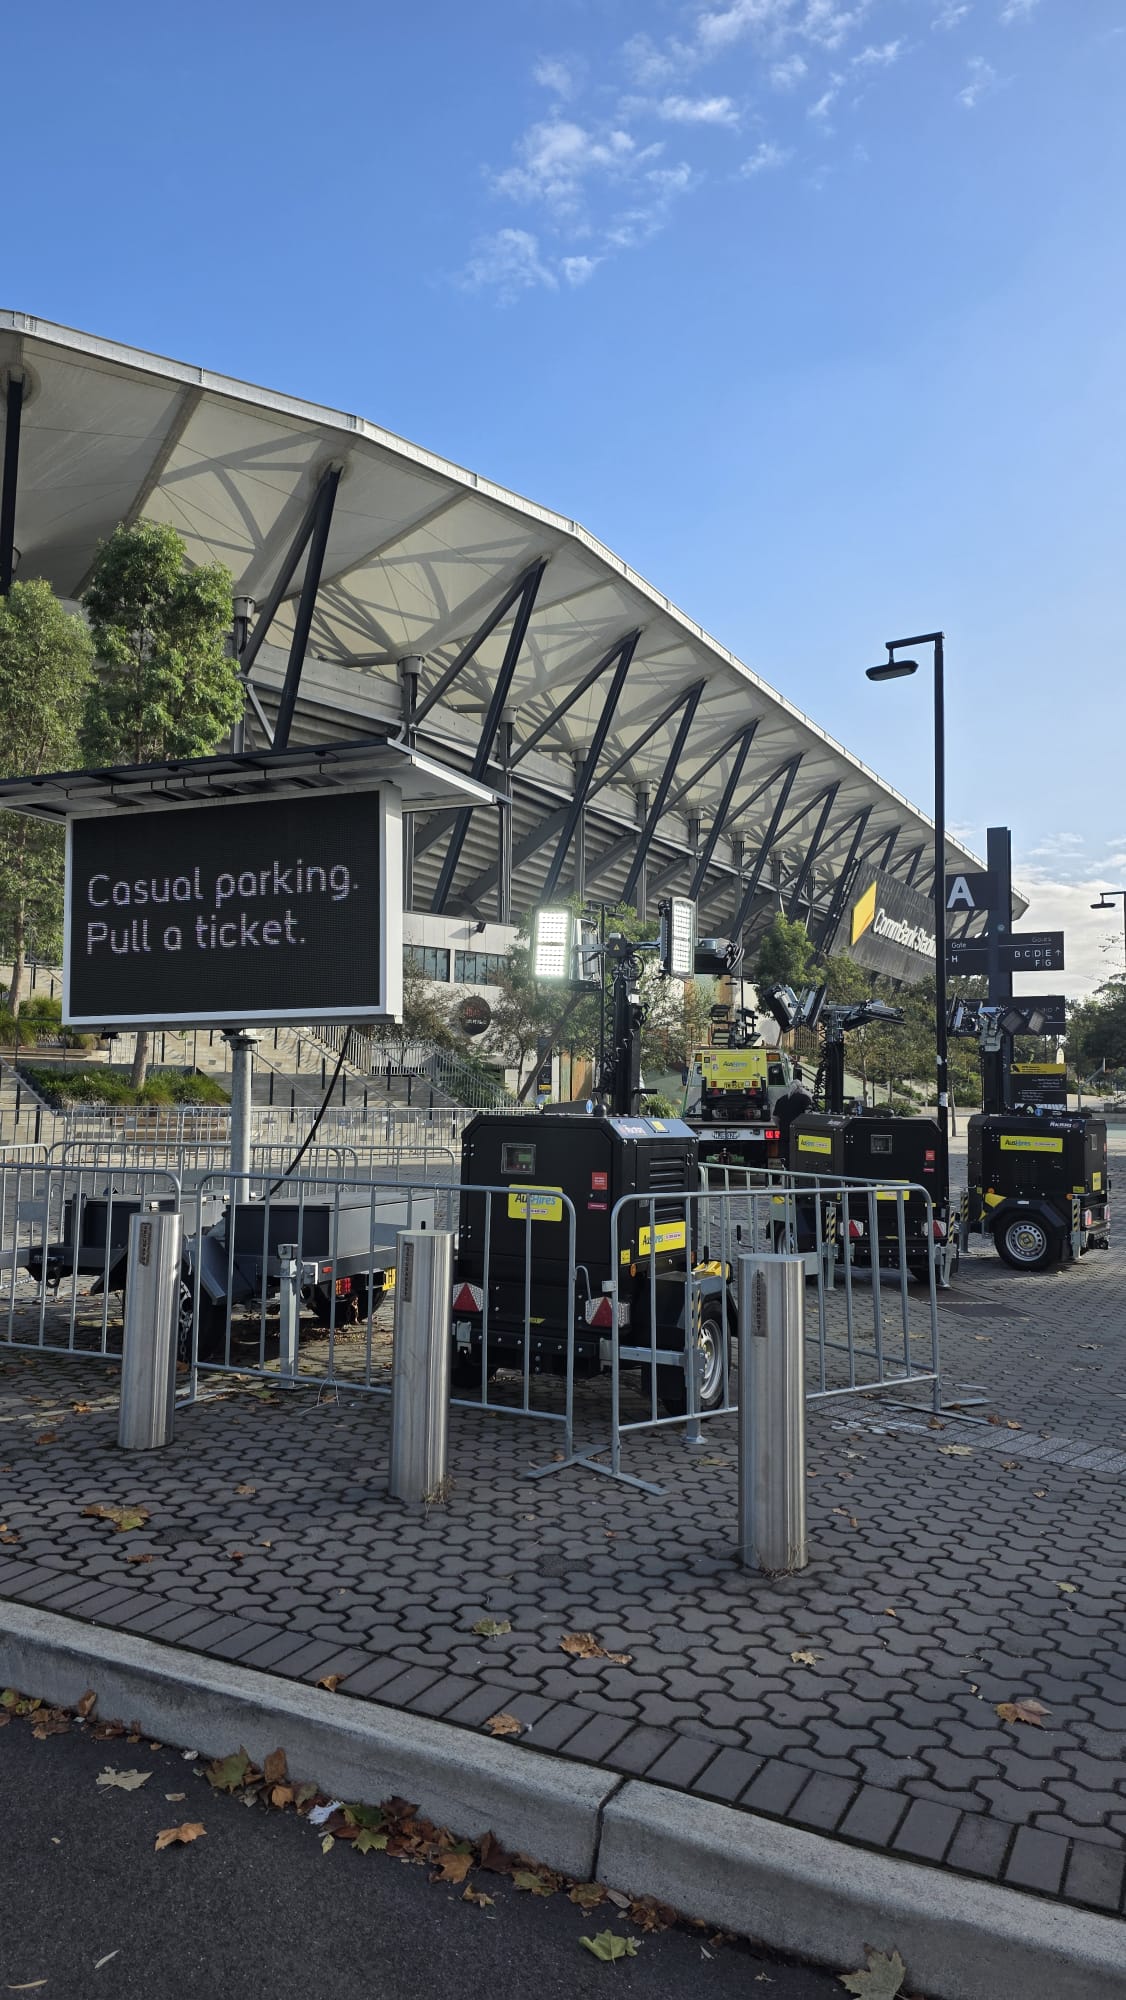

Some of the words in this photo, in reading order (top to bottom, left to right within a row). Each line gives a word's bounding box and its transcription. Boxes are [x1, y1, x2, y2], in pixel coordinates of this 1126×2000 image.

[87, 867, 204, 907] Casual
[215, 859, 358, 909] parking.
[946, 876, 976, 909] A
[87, 920, 152, 955] Pull
[163, 926, 182, 951] a
[195, 910, 306, 950] ticket.
[951, 941, 967, 949] Gate
[1034, 949, 1041, 957] D
[1045, 949, 1052, 957] E
[951, 955, 958, 963] H
[1035, 959, 1041, 967] F
[1045, 959, 1052, 967] G
